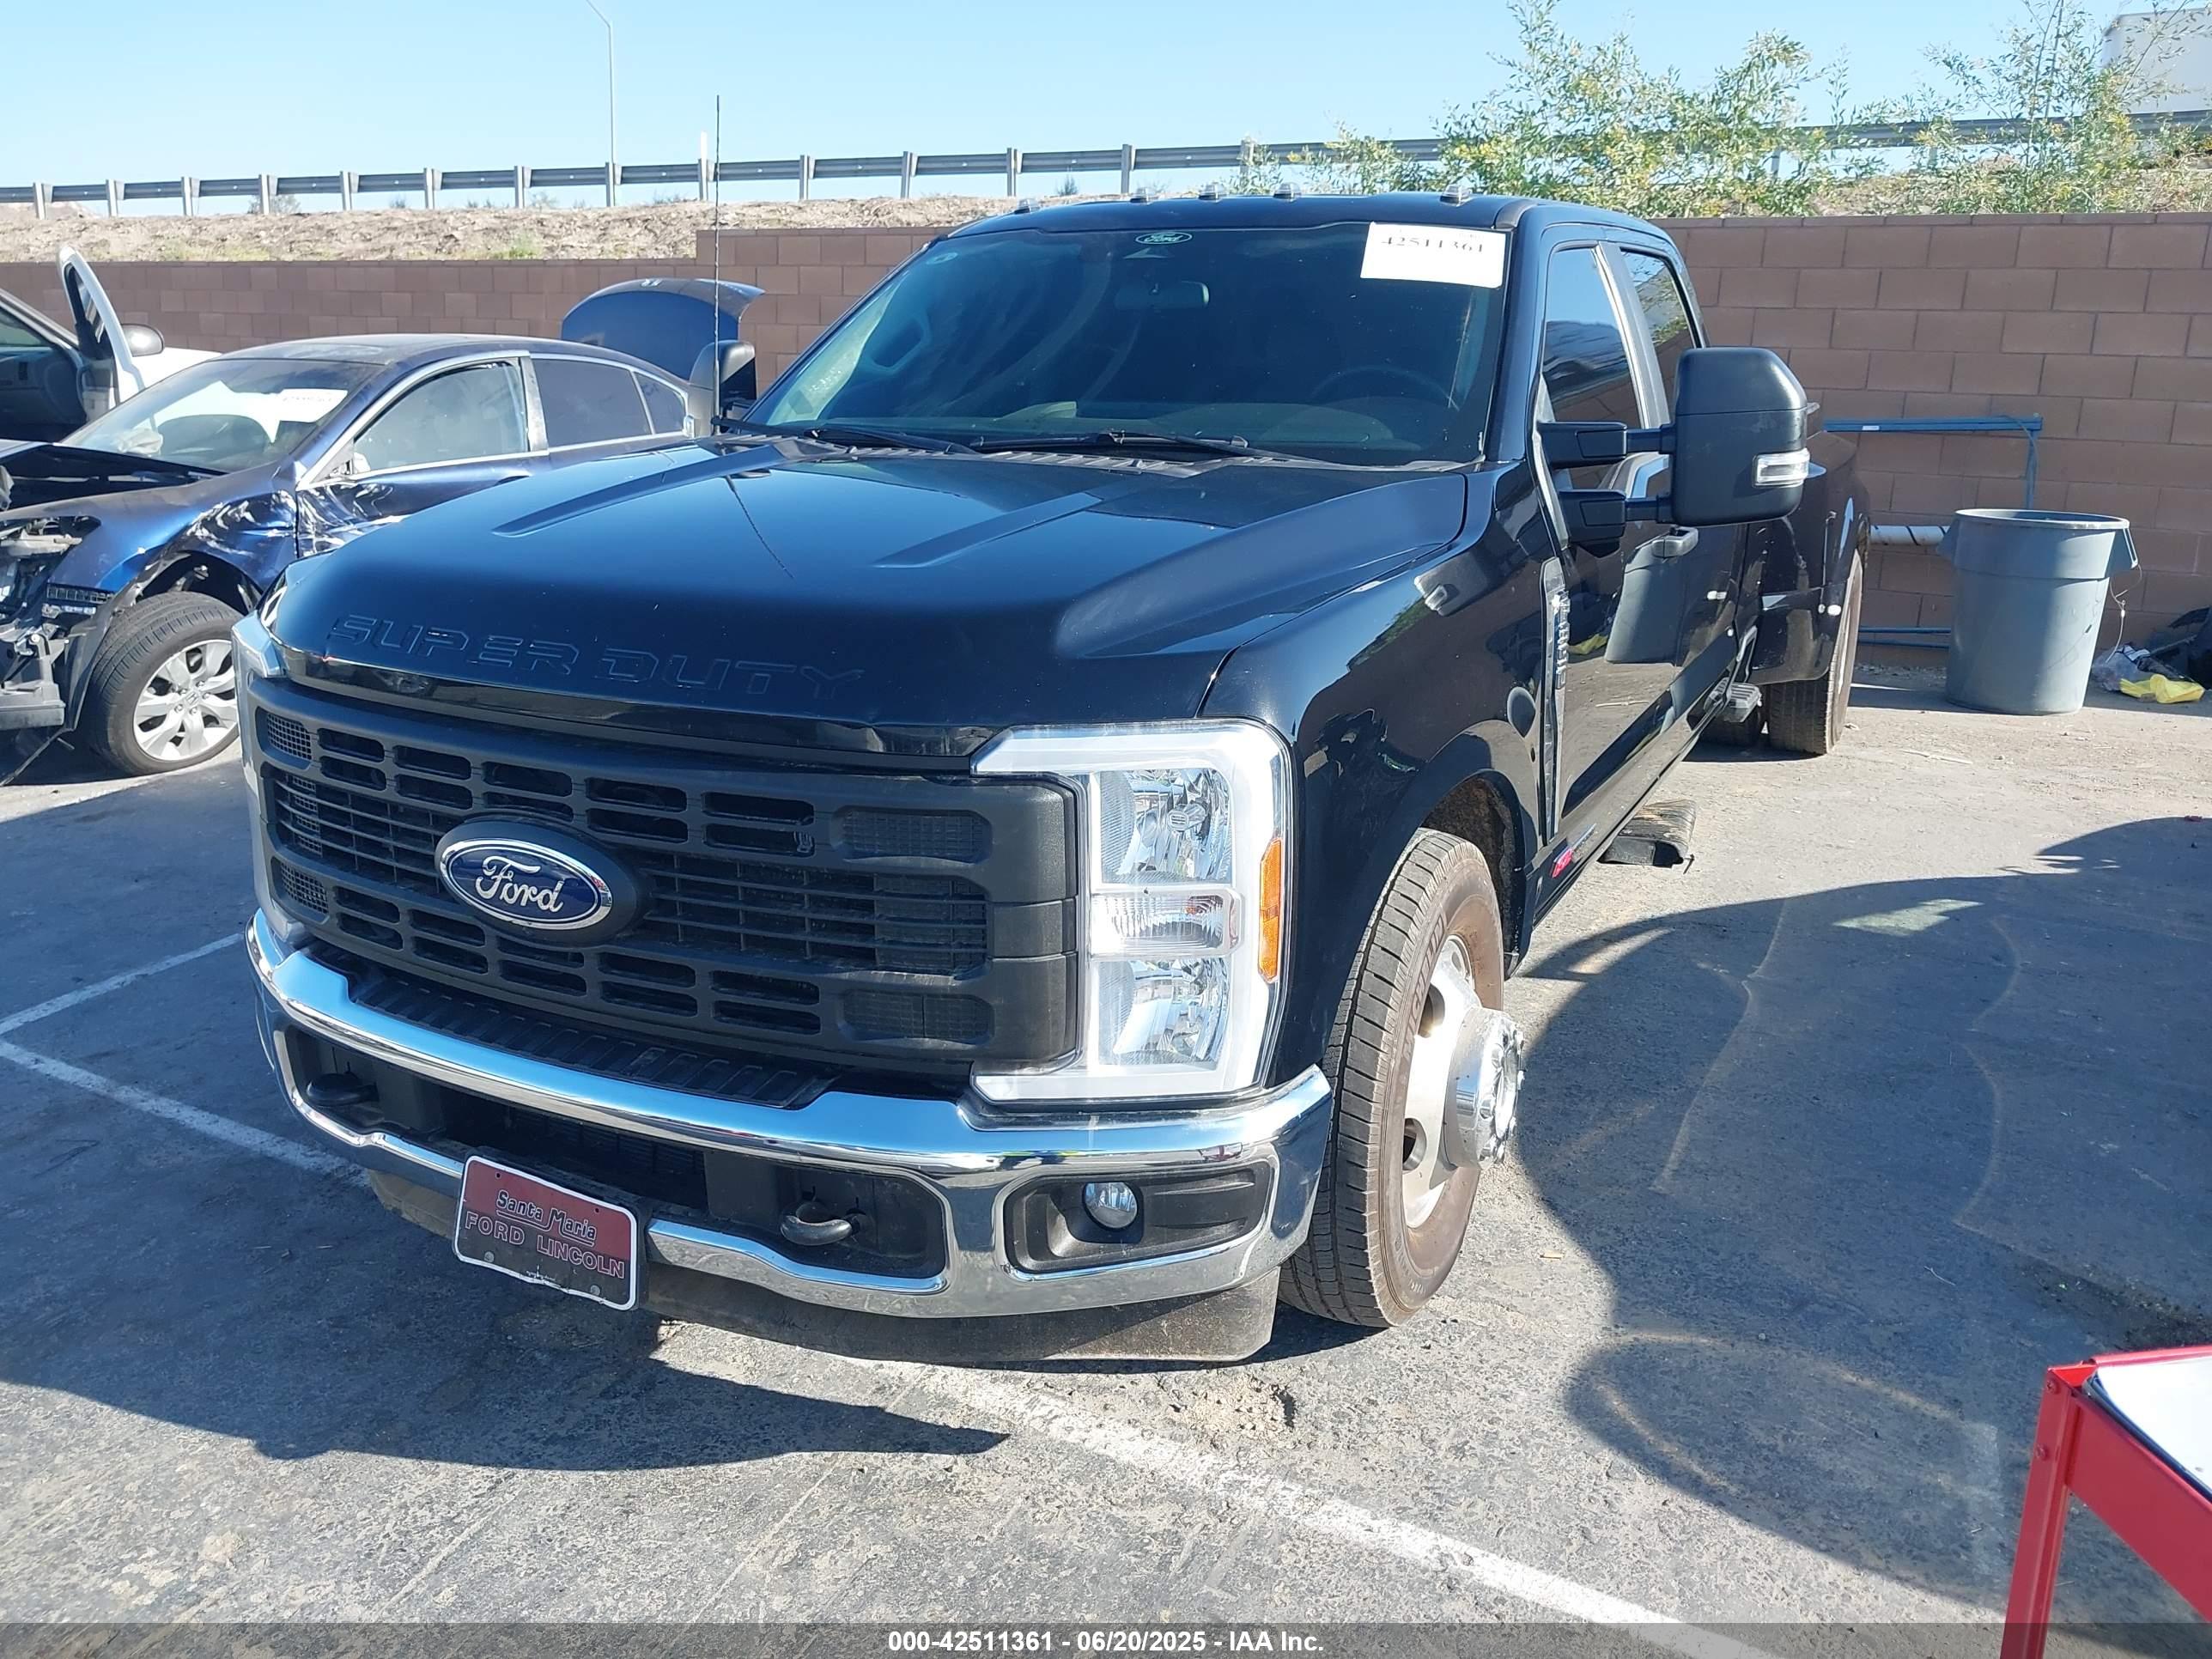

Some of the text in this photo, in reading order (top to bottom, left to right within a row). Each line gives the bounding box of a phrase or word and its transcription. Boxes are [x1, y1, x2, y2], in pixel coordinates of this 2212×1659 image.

[1380, 235, 1484, 253] 42511361
[326, 613, 866, 701] SUPER DUTY
[475, 855, 564, 913] Ford
[495, 1188, 598, 1242] Santa Maria
[465, 1211, 626, 1279] FORD LINCOLN
